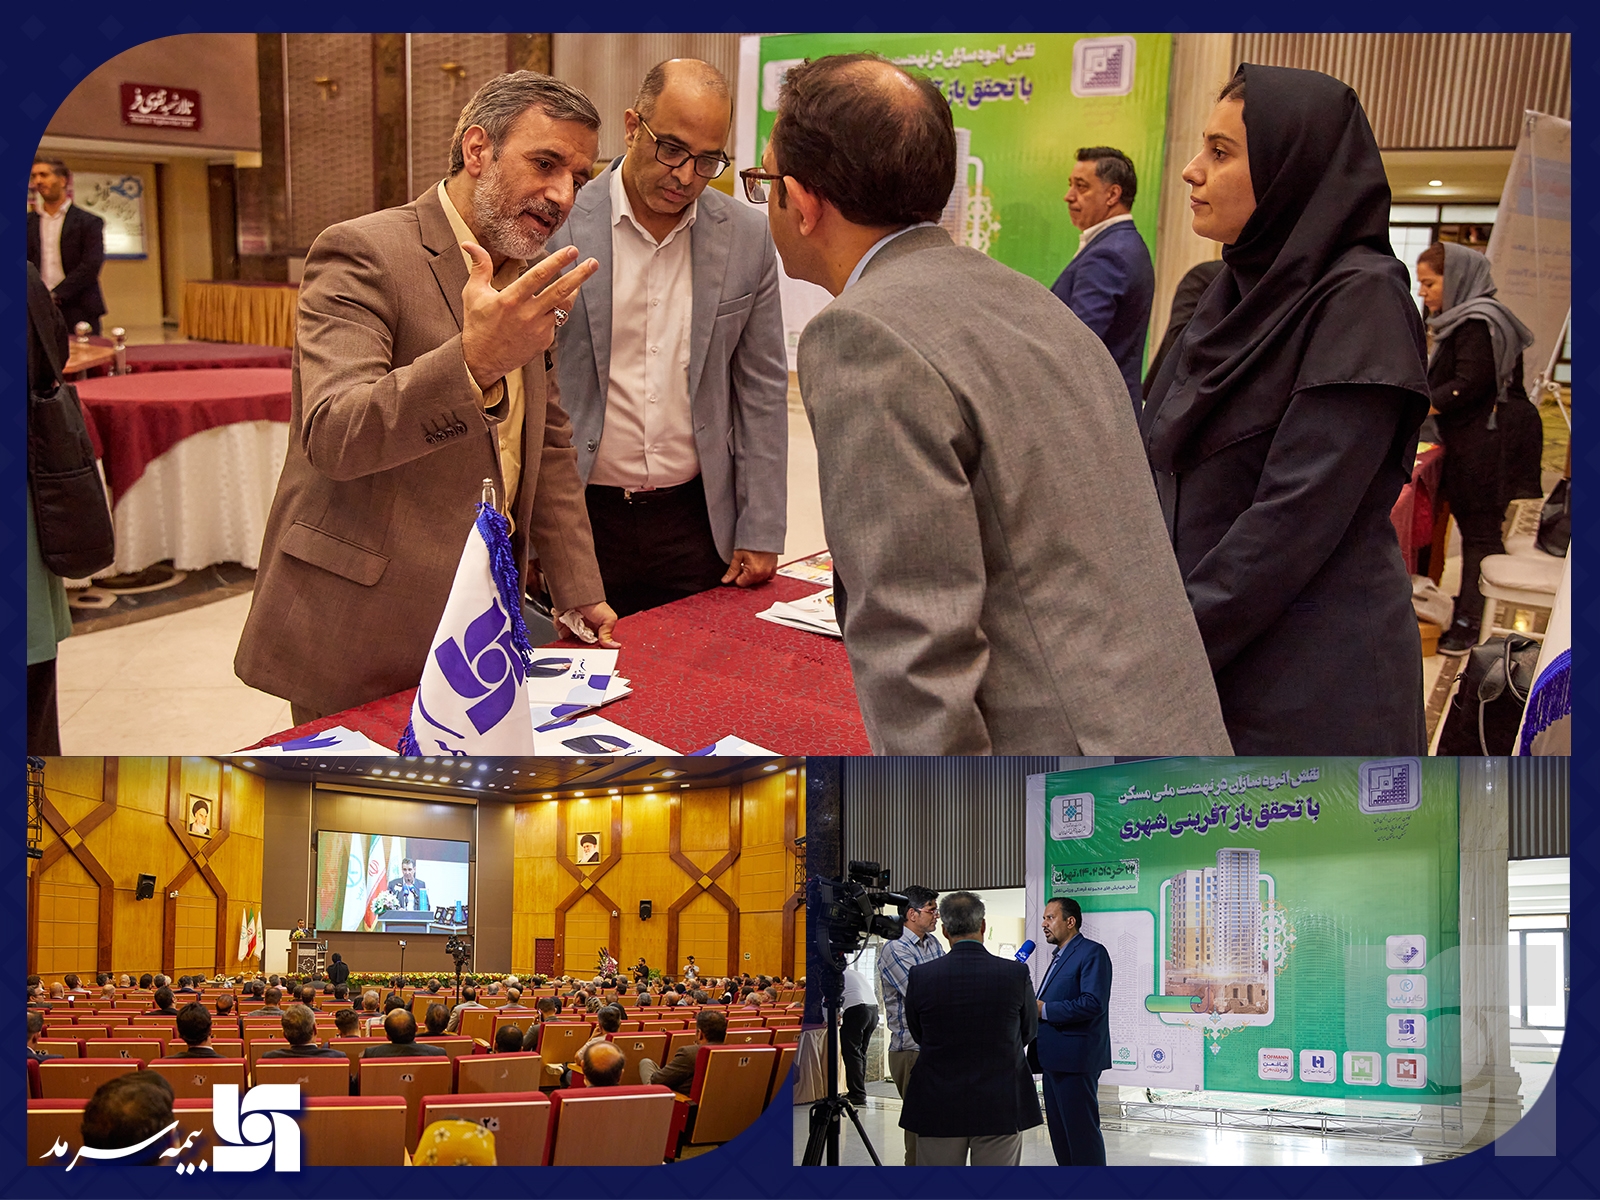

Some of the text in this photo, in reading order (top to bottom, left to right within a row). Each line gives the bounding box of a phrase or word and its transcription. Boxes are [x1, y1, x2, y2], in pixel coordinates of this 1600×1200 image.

[966, 77, 1016, 110] تحقق
[1019, 75, 1033, 104] با
[1118, 767, 1320, 805] نقش انبوه سازان در نهضت ملی مسکن
[1254, 799, 1303, 830] تحقق
[1305, 797, 1320, 823] با
[1119, 811, 1168, 841] شهری
